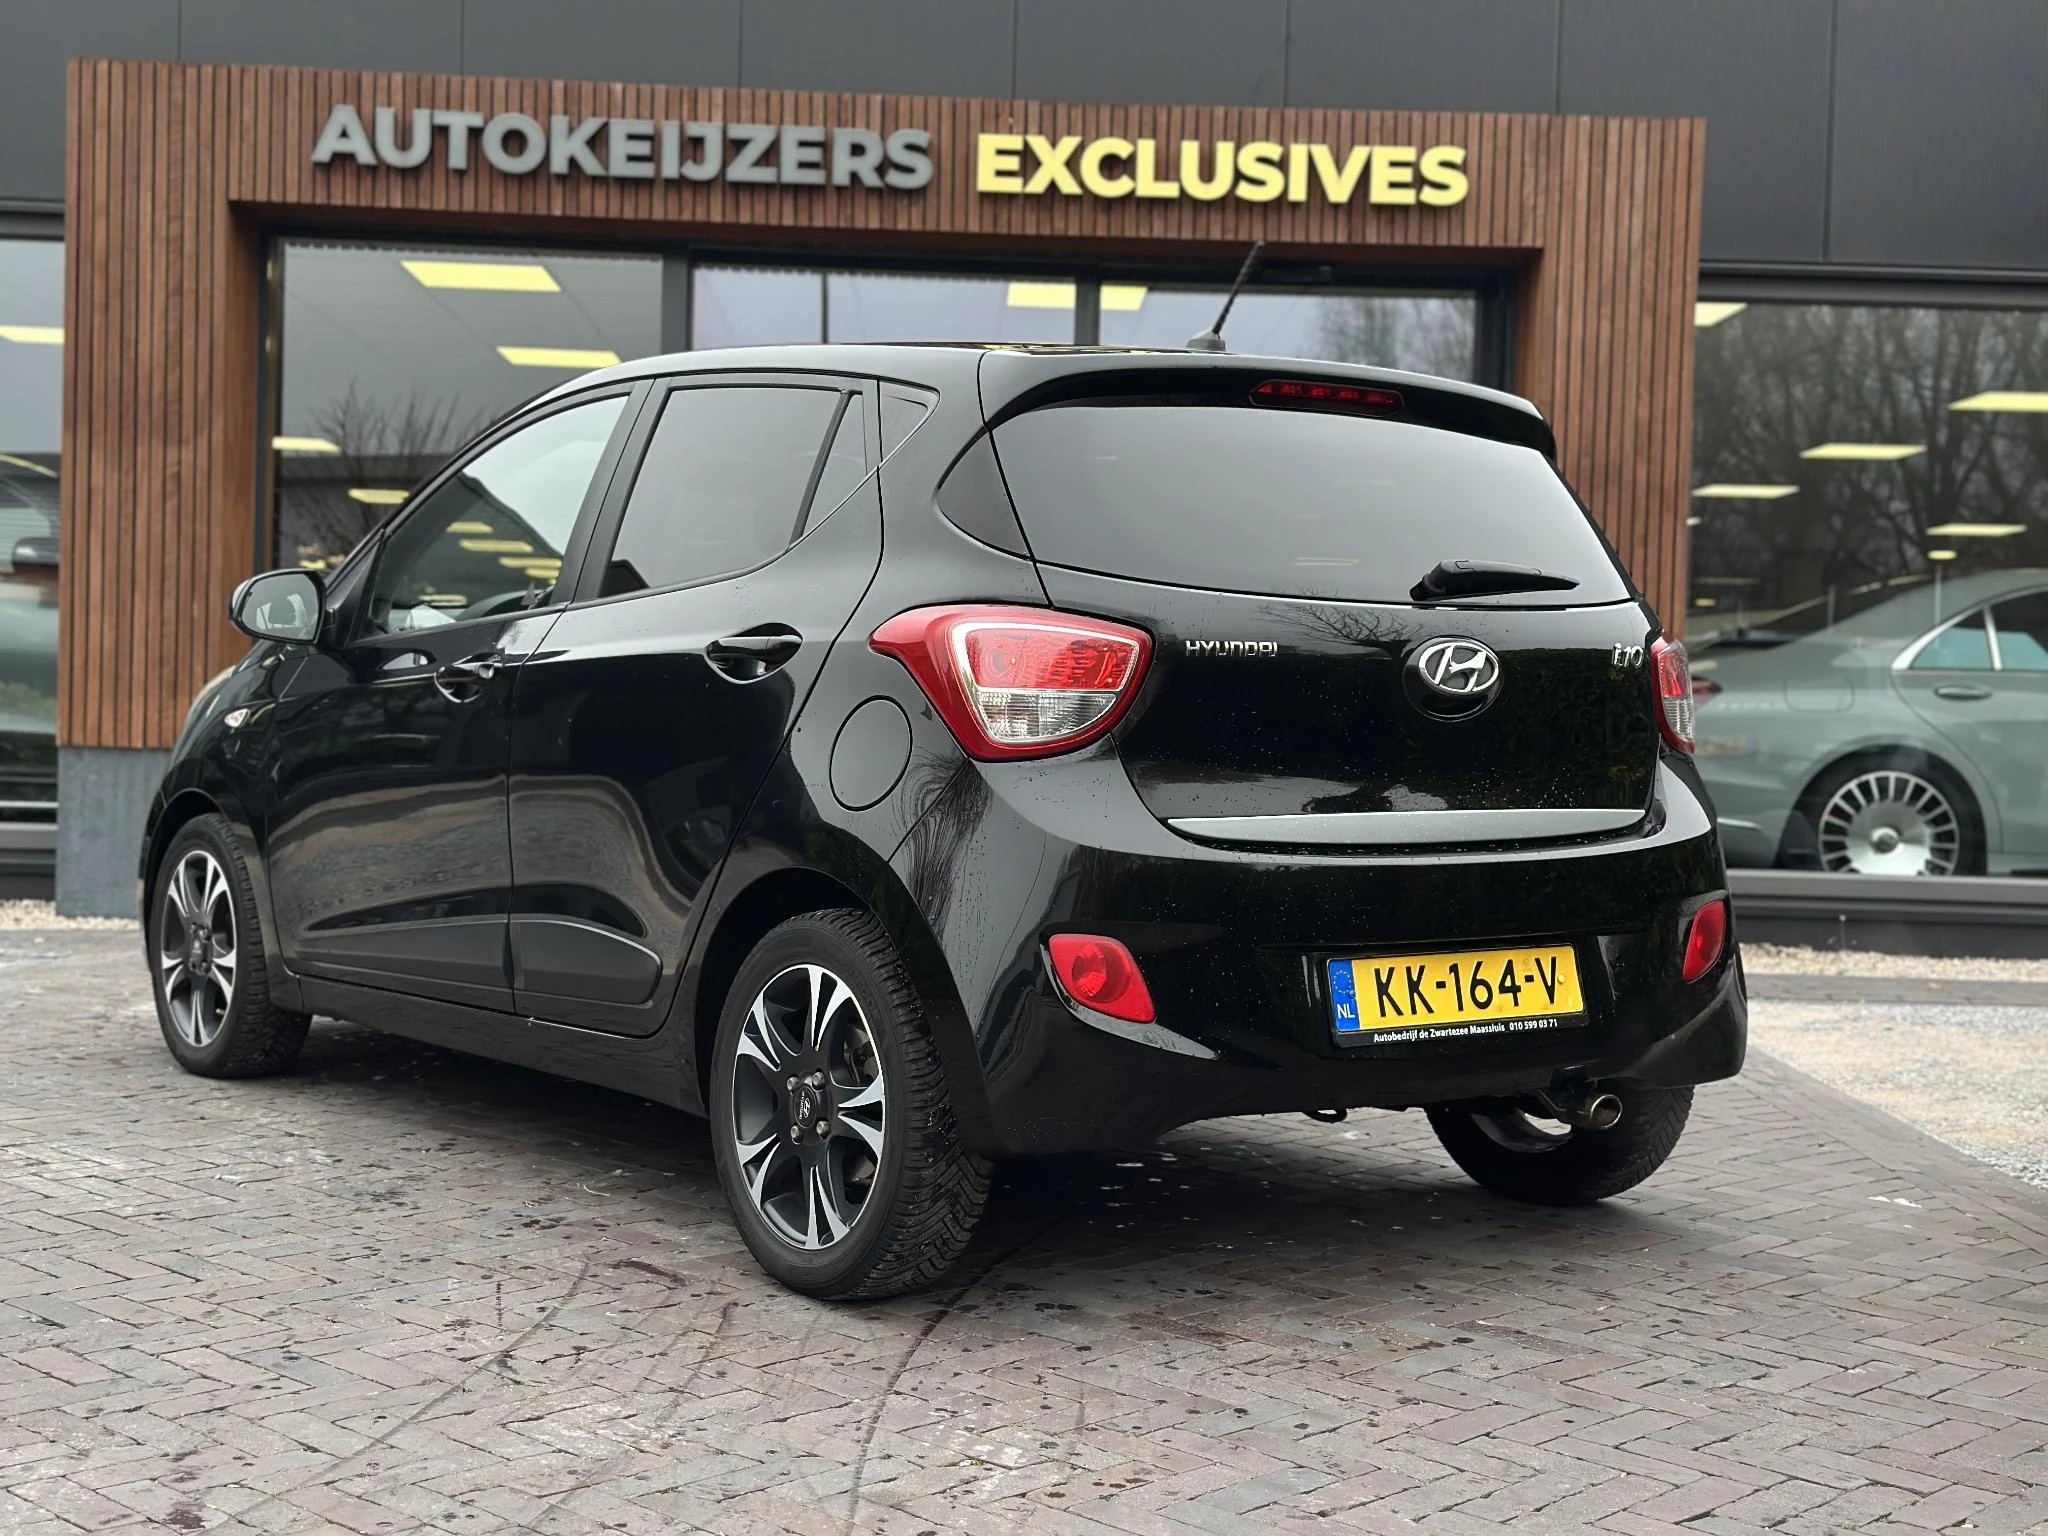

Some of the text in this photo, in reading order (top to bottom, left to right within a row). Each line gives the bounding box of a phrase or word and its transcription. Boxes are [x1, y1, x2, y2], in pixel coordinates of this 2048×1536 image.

[310, 103, 1470, 207] AUTOKEIJZERS EXCLUSIVES
[1185, 640, 1278, 657] HYUNDAI
[1611, 642, 1645, 668] i10
[1373, 955, 1558, 1018] KK-164-V
[1336, 1003, 1356, 1019] NL
[1373, 1018, 1558, 1043] Autobedrijf de Zwartezee Maassluis 010 599 03 71
